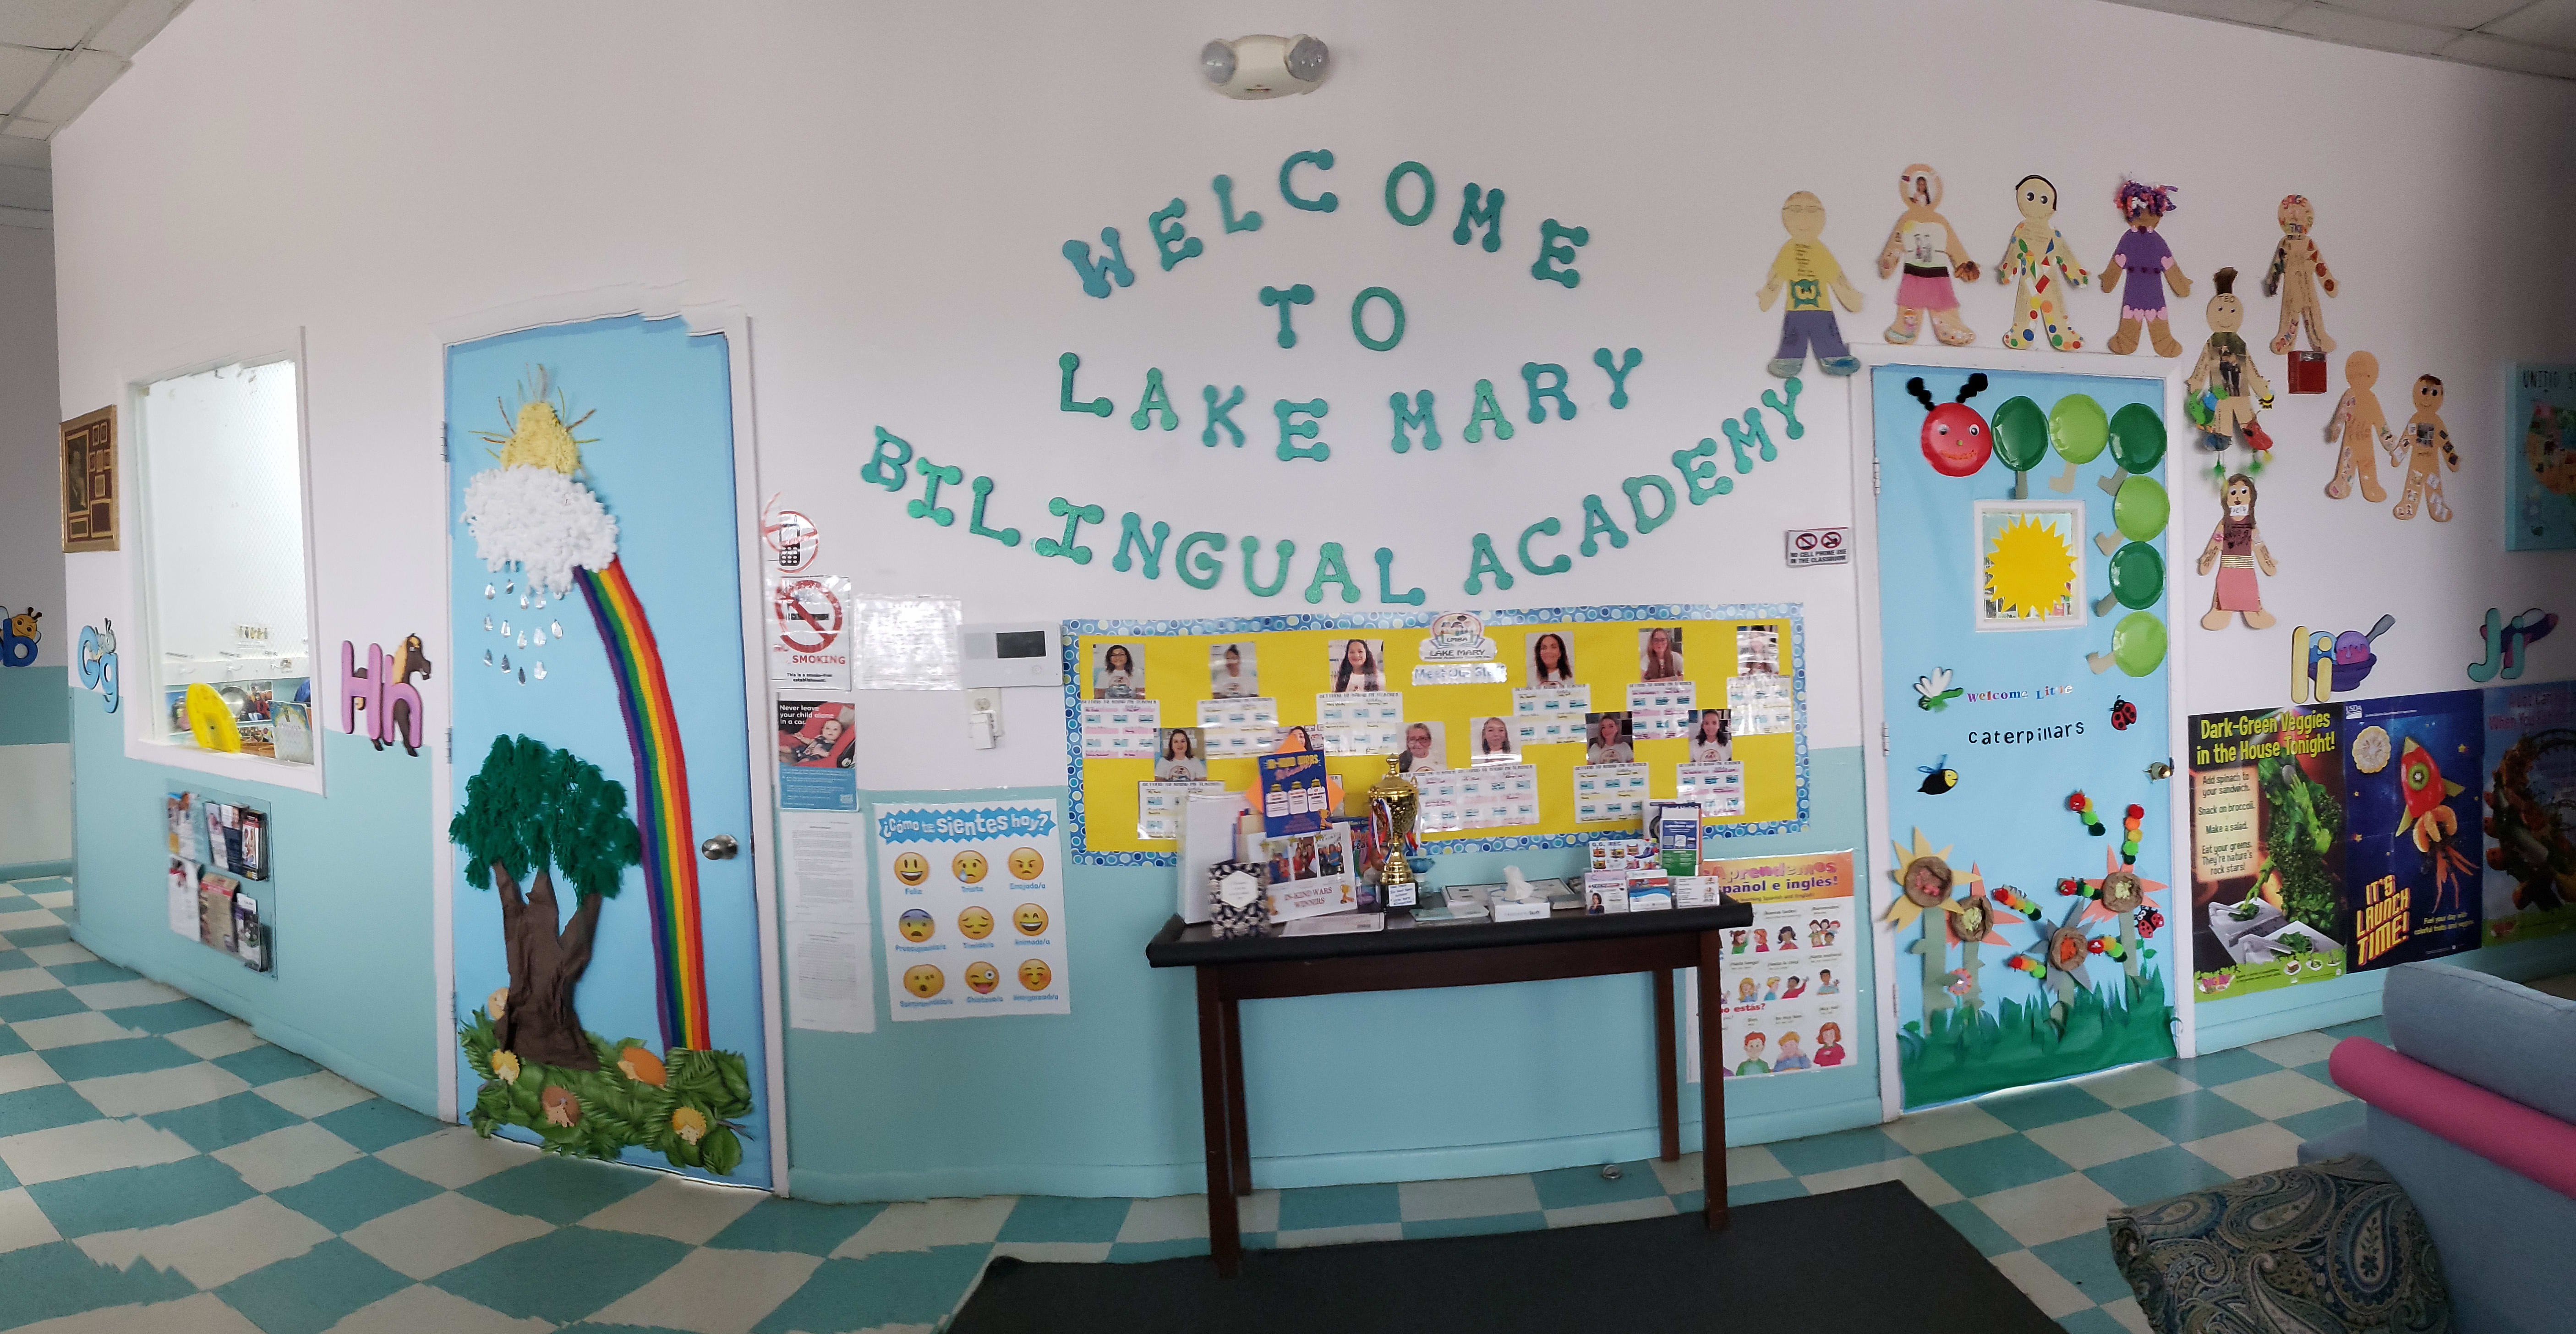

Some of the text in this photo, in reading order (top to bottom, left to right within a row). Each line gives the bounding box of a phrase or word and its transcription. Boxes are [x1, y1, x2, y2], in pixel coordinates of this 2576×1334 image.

[1062, 149, 1589, 298] WELCOME
[1259, 283, 1406, 351] TO
[1059, 347, 1642, 461] LAKE MARY
[861, 377, 1804, 605] BILINGUAL ACADEMY
[0, 618, 38, 667] b
[792, 655, 846, 664] SMOKING
[2467, 608, 2524, 682] Jj
[77, 625, 119, 714] Gg
[341, 640, 422, 748] Hh
[1967, 685, 2073, 703] Welcome Litle
[1969, 721, 2085, 745] caterpillars
[2201, 710, 2330, 740] Dark-Green Veggies
[2196, 731, 2335, 765] in the House Tonight!
[936, 813, 1008, 836] sientes
[1011, 813, 1049, 832] hoy?
[1312, 887, 1332, 896] WARS
[1719, 880, 1767, 894] pañol
[1786, 876, 1838, 891] inglés!
[2366, 874, 2396, 906] IT'S
[2356, 887, 2411, 938] LAUNCH
[2357, 911, 2411, 966] TIME!
[1734, 1003, 1766, 1013] estás?
